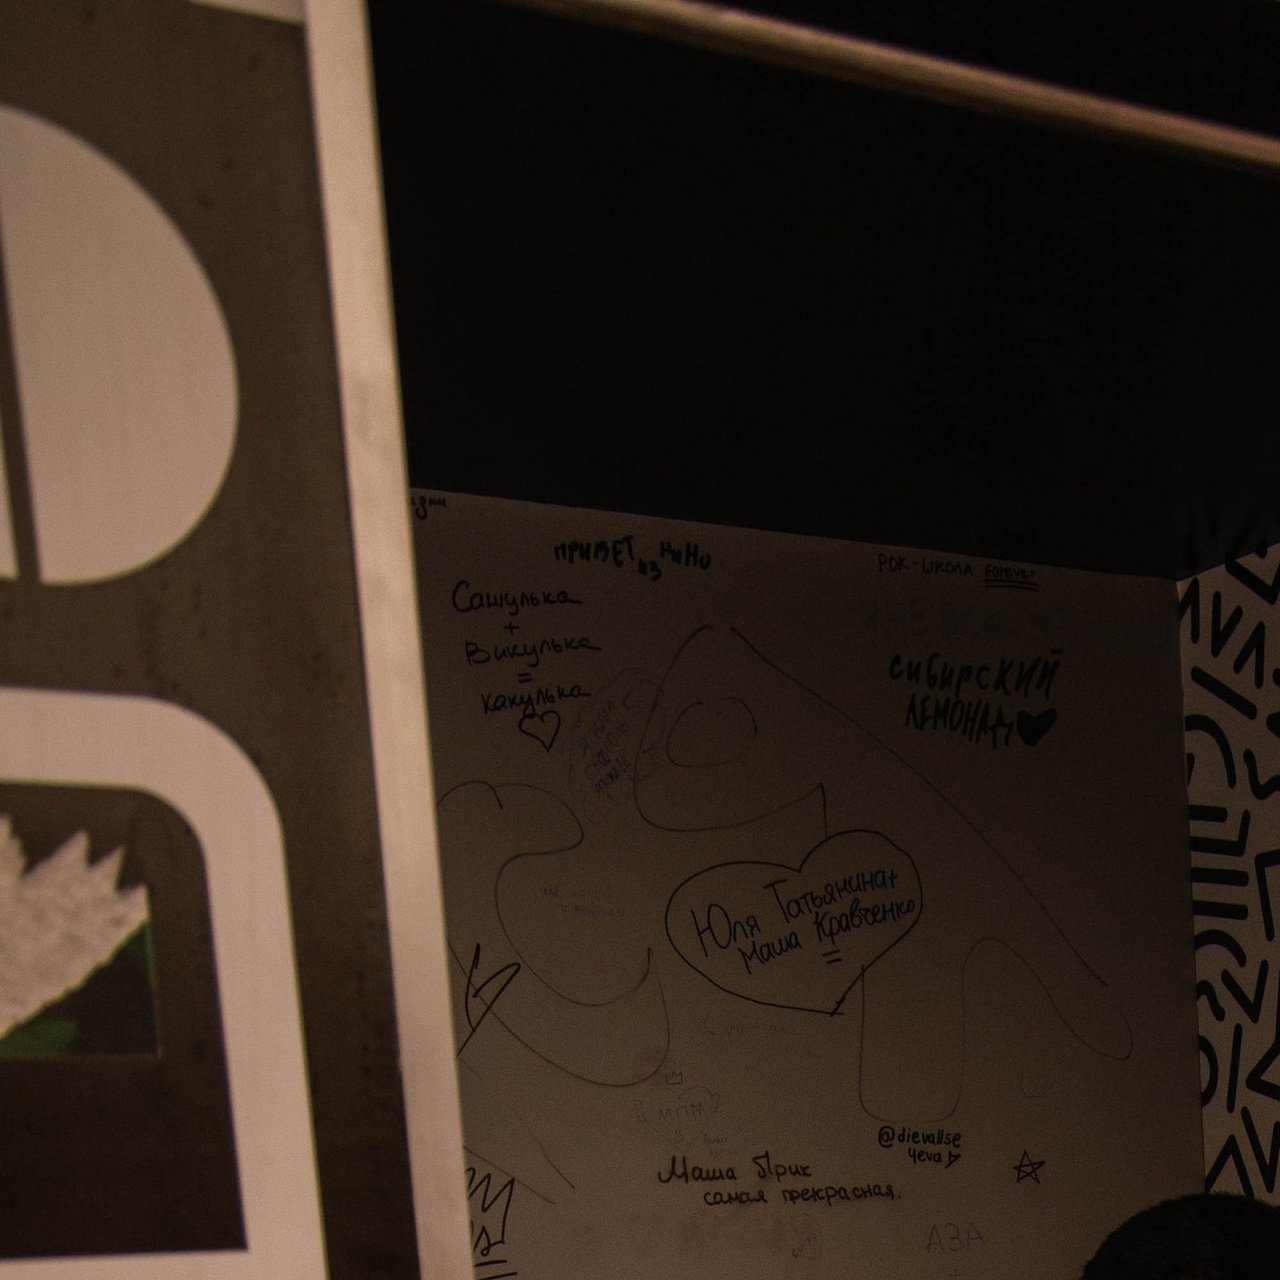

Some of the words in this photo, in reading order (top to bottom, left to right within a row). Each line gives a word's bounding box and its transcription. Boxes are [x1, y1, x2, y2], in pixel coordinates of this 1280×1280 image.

[451, 579, 583, 617] Сашулька
[465, 636, 602, 668] Викулька
[904, 692, 1014, 750] ЛЕМОНАД
[691, 902, 762, 957] Юля
[737, 931, 802, 975] Маша
[814, 897, 916, 946] Кравченко
[657, 1154, 737, 1184] Маша
[703, 1189, 768, 1206] самая
